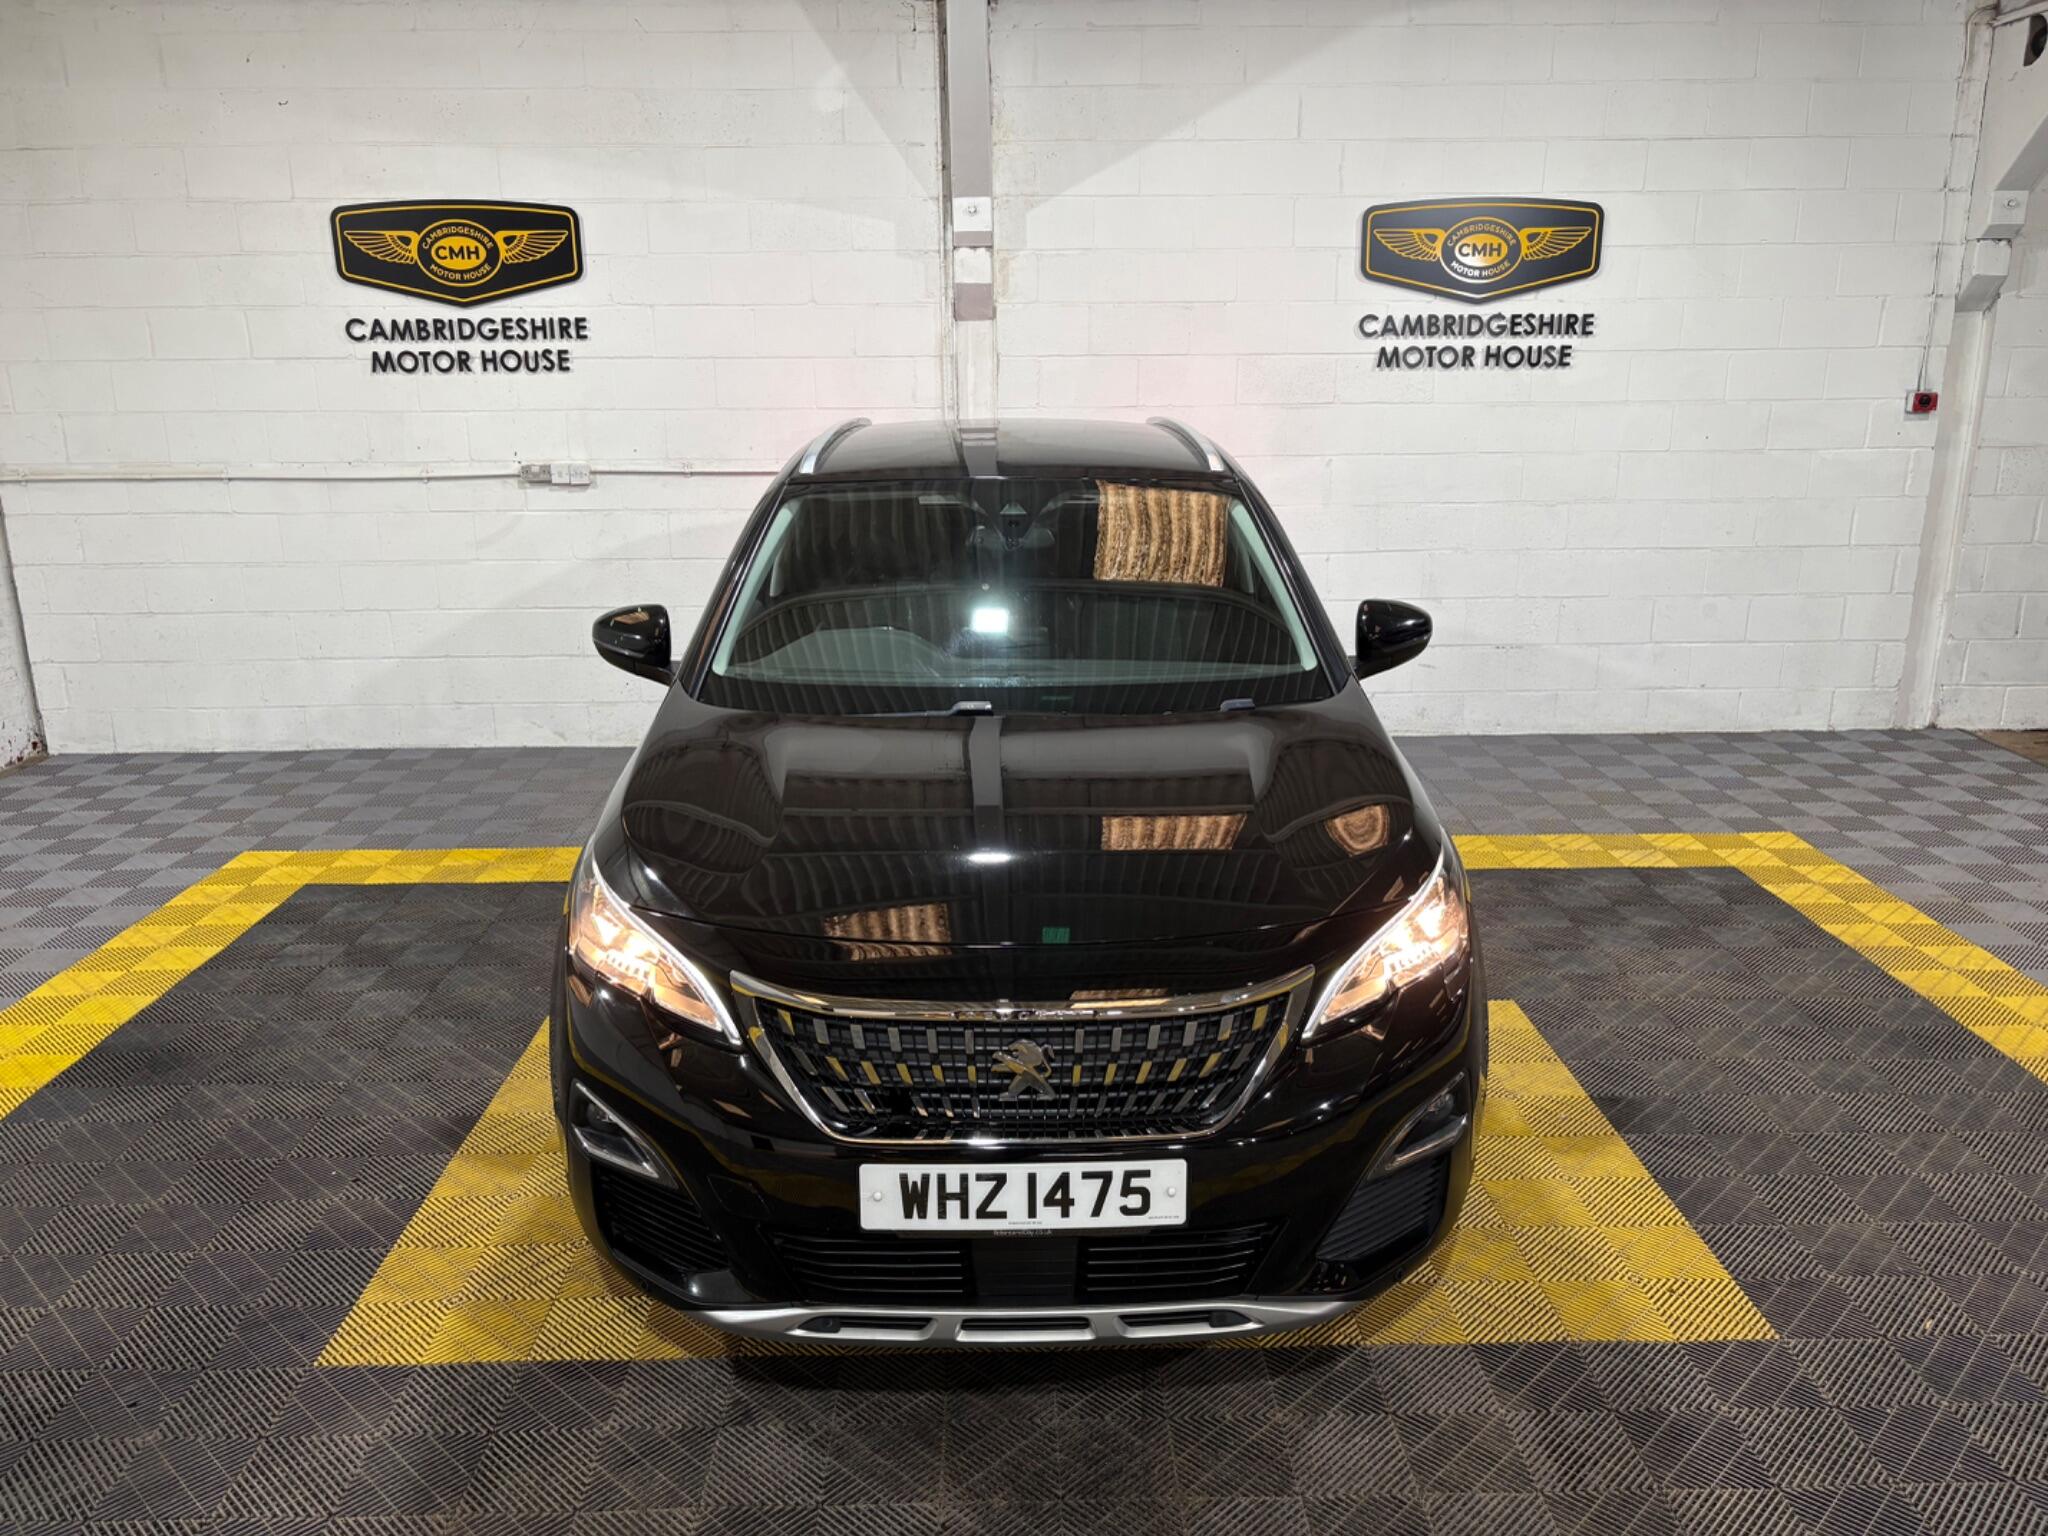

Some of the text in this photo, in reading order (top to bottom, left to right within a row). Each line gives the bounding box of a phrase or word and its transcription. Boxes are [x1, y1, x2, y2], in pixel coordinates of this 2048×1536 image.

[422, 225, 494, 249] CAMBRIDGESHIRE
[1447, 223, 1516, 246] CAMBRIDGESHIRE
[435, 245, 480, 260] CMH
[1458, 242, 1502, 258] CMH
[430, 262, 492, 280] MOTOR HOUSE
[1451, 259, 1511, 277] MOTOR HOUSE
[345, 317, 589, 342] CAMBRIDGESHIRE
[1358, 313, 1595, 339] CAMBRIDGESHIRE
[371, 348, 571, 374] MOTOR HOUSE
[1376, 344, 1573, 369] MOTOR HOUSE
[898, 1169, 1152, 1220] WHZ 1475
